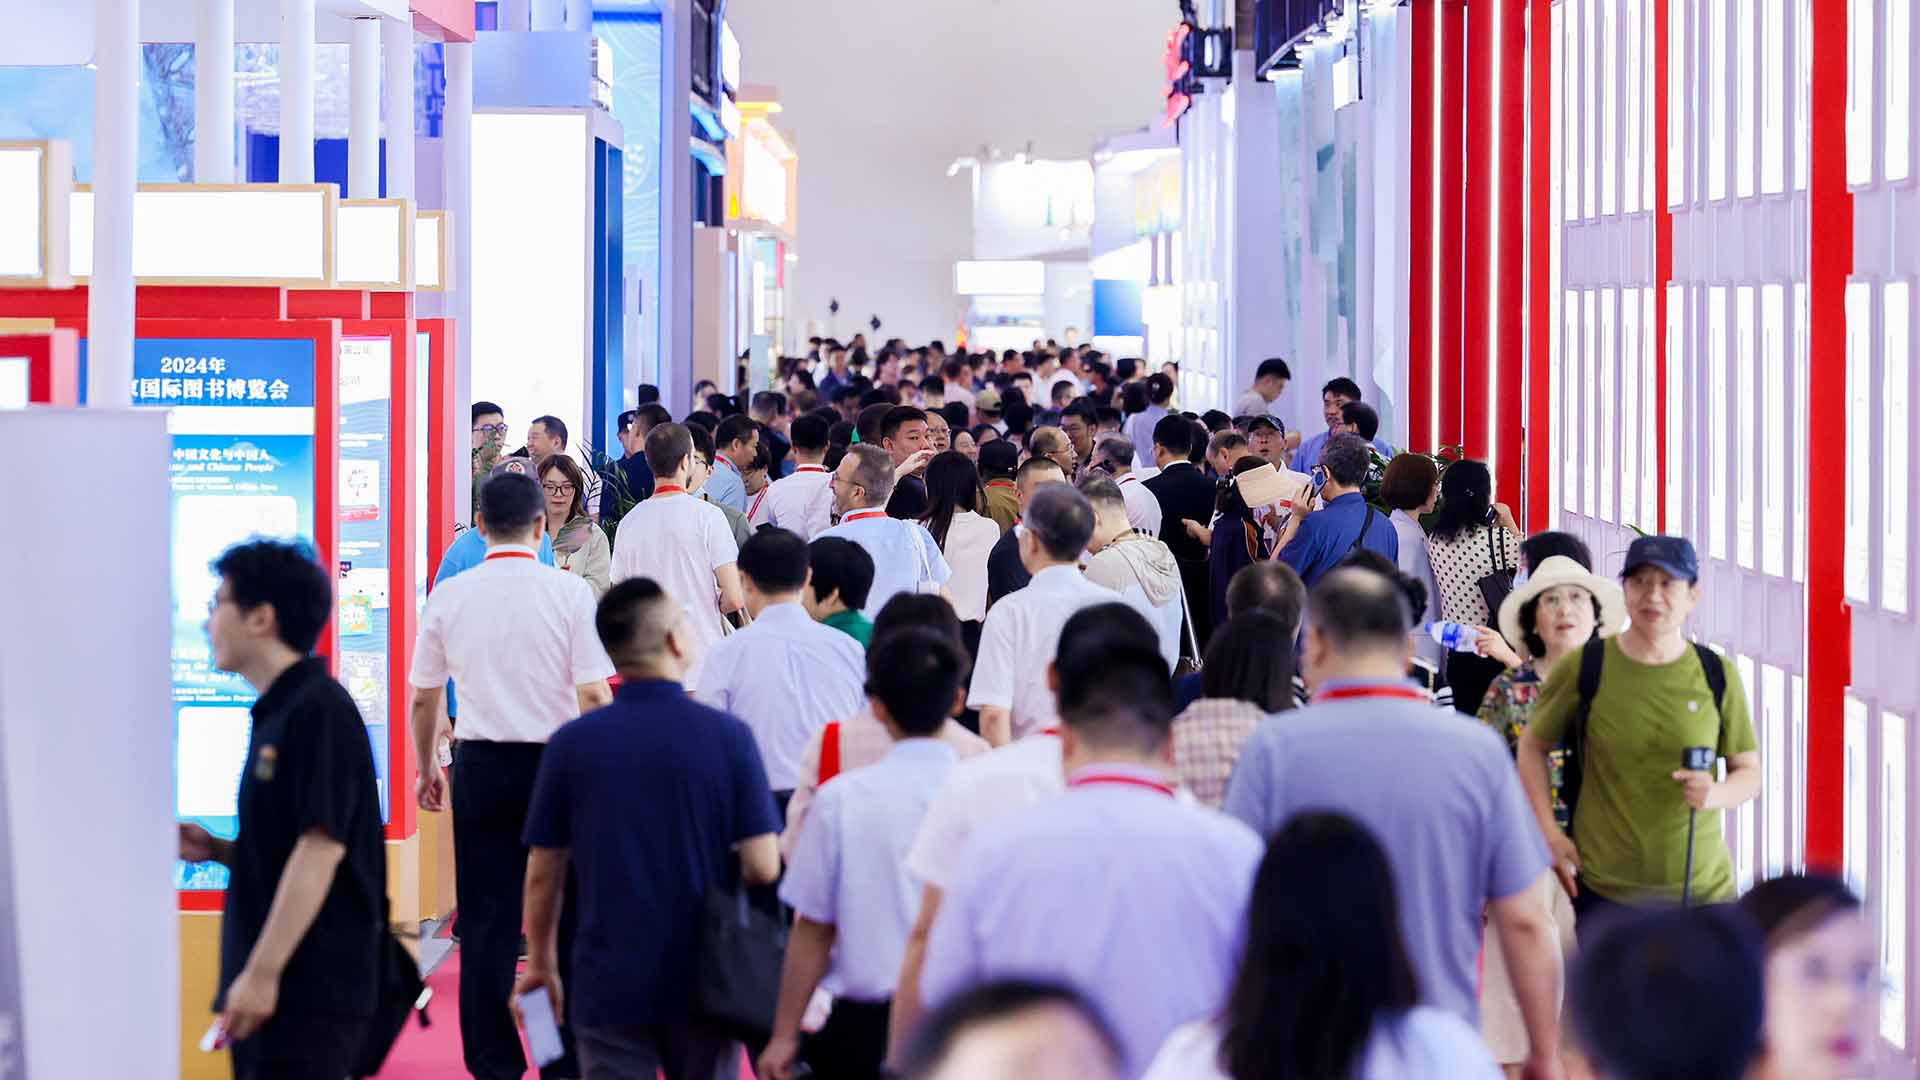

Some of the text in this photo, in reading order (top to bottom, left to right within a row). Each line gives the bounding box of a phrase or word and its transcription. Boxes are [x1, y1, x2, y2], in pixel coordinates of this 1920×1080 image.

[160, 356, 226, 374] 2024年
[172, 447, 271, 461] 中国文化与中国人
